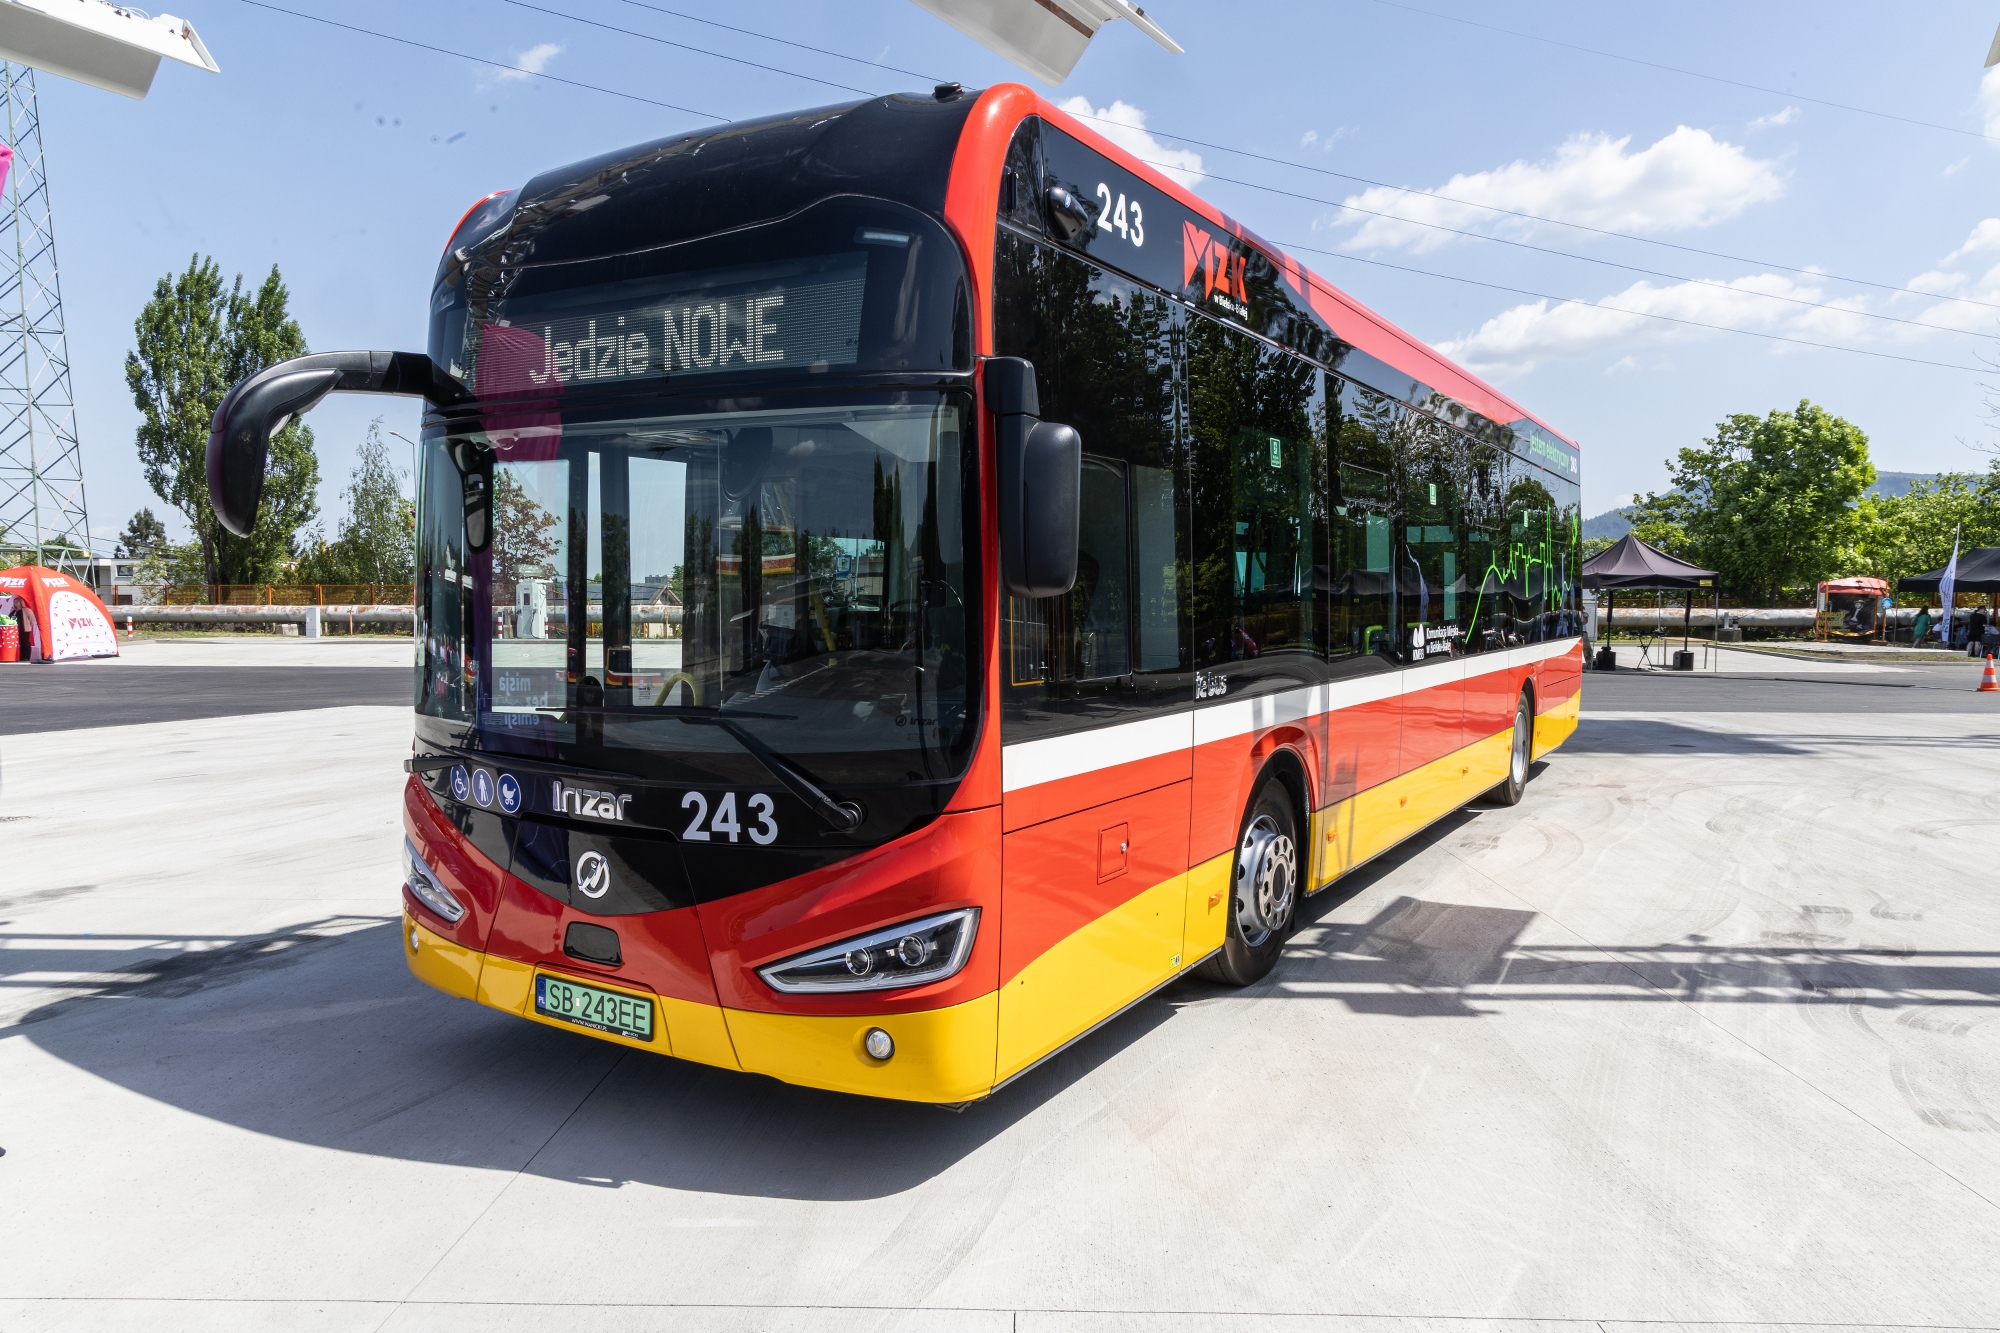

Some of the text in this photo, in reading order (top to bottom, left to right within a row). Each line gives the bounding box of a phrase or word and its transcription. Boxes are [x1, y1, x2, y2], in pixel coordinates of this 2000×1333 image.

[1097, 182, 1145, 247] 243
[1183, 220, 1248, 304] MZK
[529, 295, 784, 385] Jedzie NOWE
[1208, 671, 1227, 697] bus
[681, 791, 778, 845] 243
[538, 996, 545, 1005] PL
[549, 983, 646, 1032] SB 243EE
